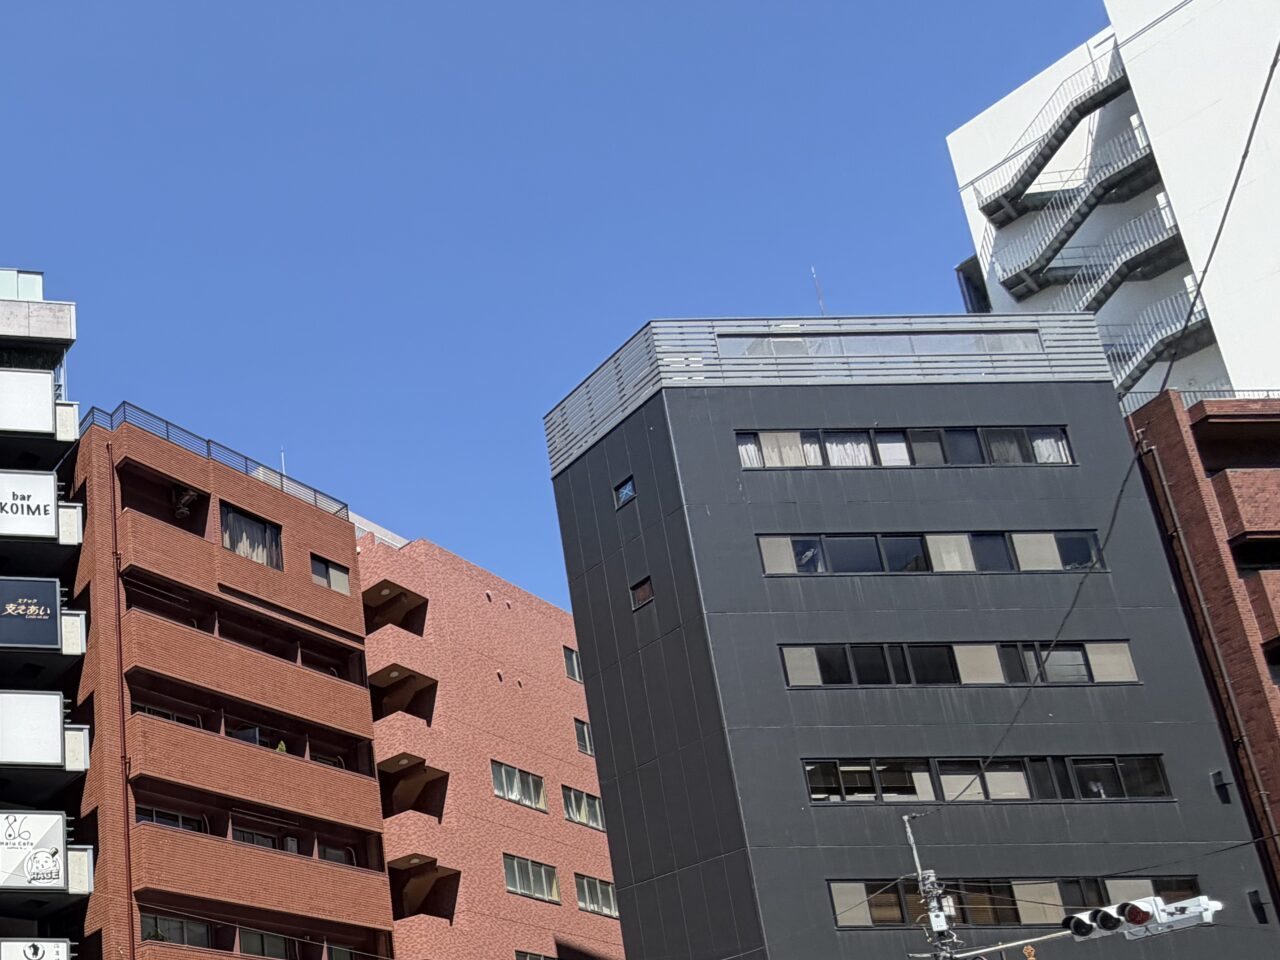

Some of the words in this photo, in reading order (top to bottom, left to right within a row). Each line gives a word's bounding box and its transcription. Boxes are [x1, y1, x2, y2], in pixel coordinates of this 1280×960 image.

[12, 491, 32, 502] bar
[0, 502, 50, 516] KOIME
[1, 603, 51, 616] 支えあい
